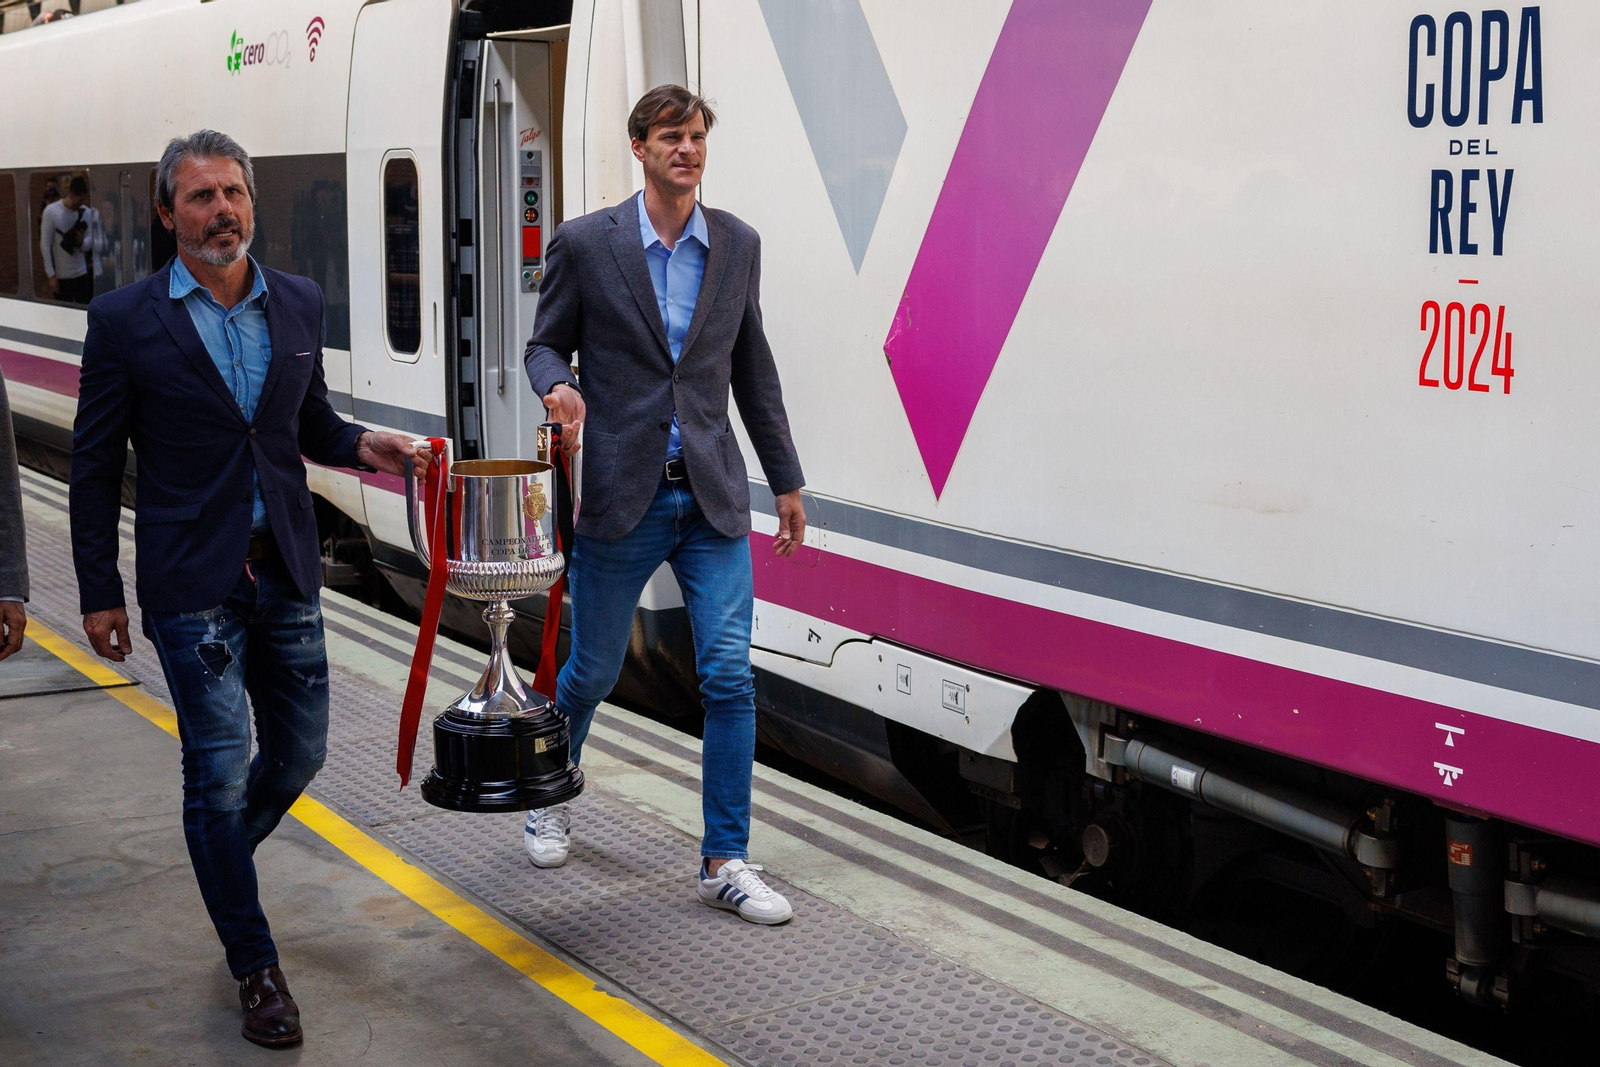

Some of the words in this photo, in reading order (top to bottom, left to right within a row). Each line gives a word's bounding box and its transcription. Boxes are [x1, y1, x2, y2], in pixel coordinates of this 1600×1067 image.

[1407, 6, 1543, 128] COPA
[519, 127, 541, 147] Talgo
[1449, 139, 1498, 155] DEL
[1429, 169, 1514, 256] REY
[1418, 300, 1514, 395] 2024
[482, 534, 540, 546] CAMPEONATO
